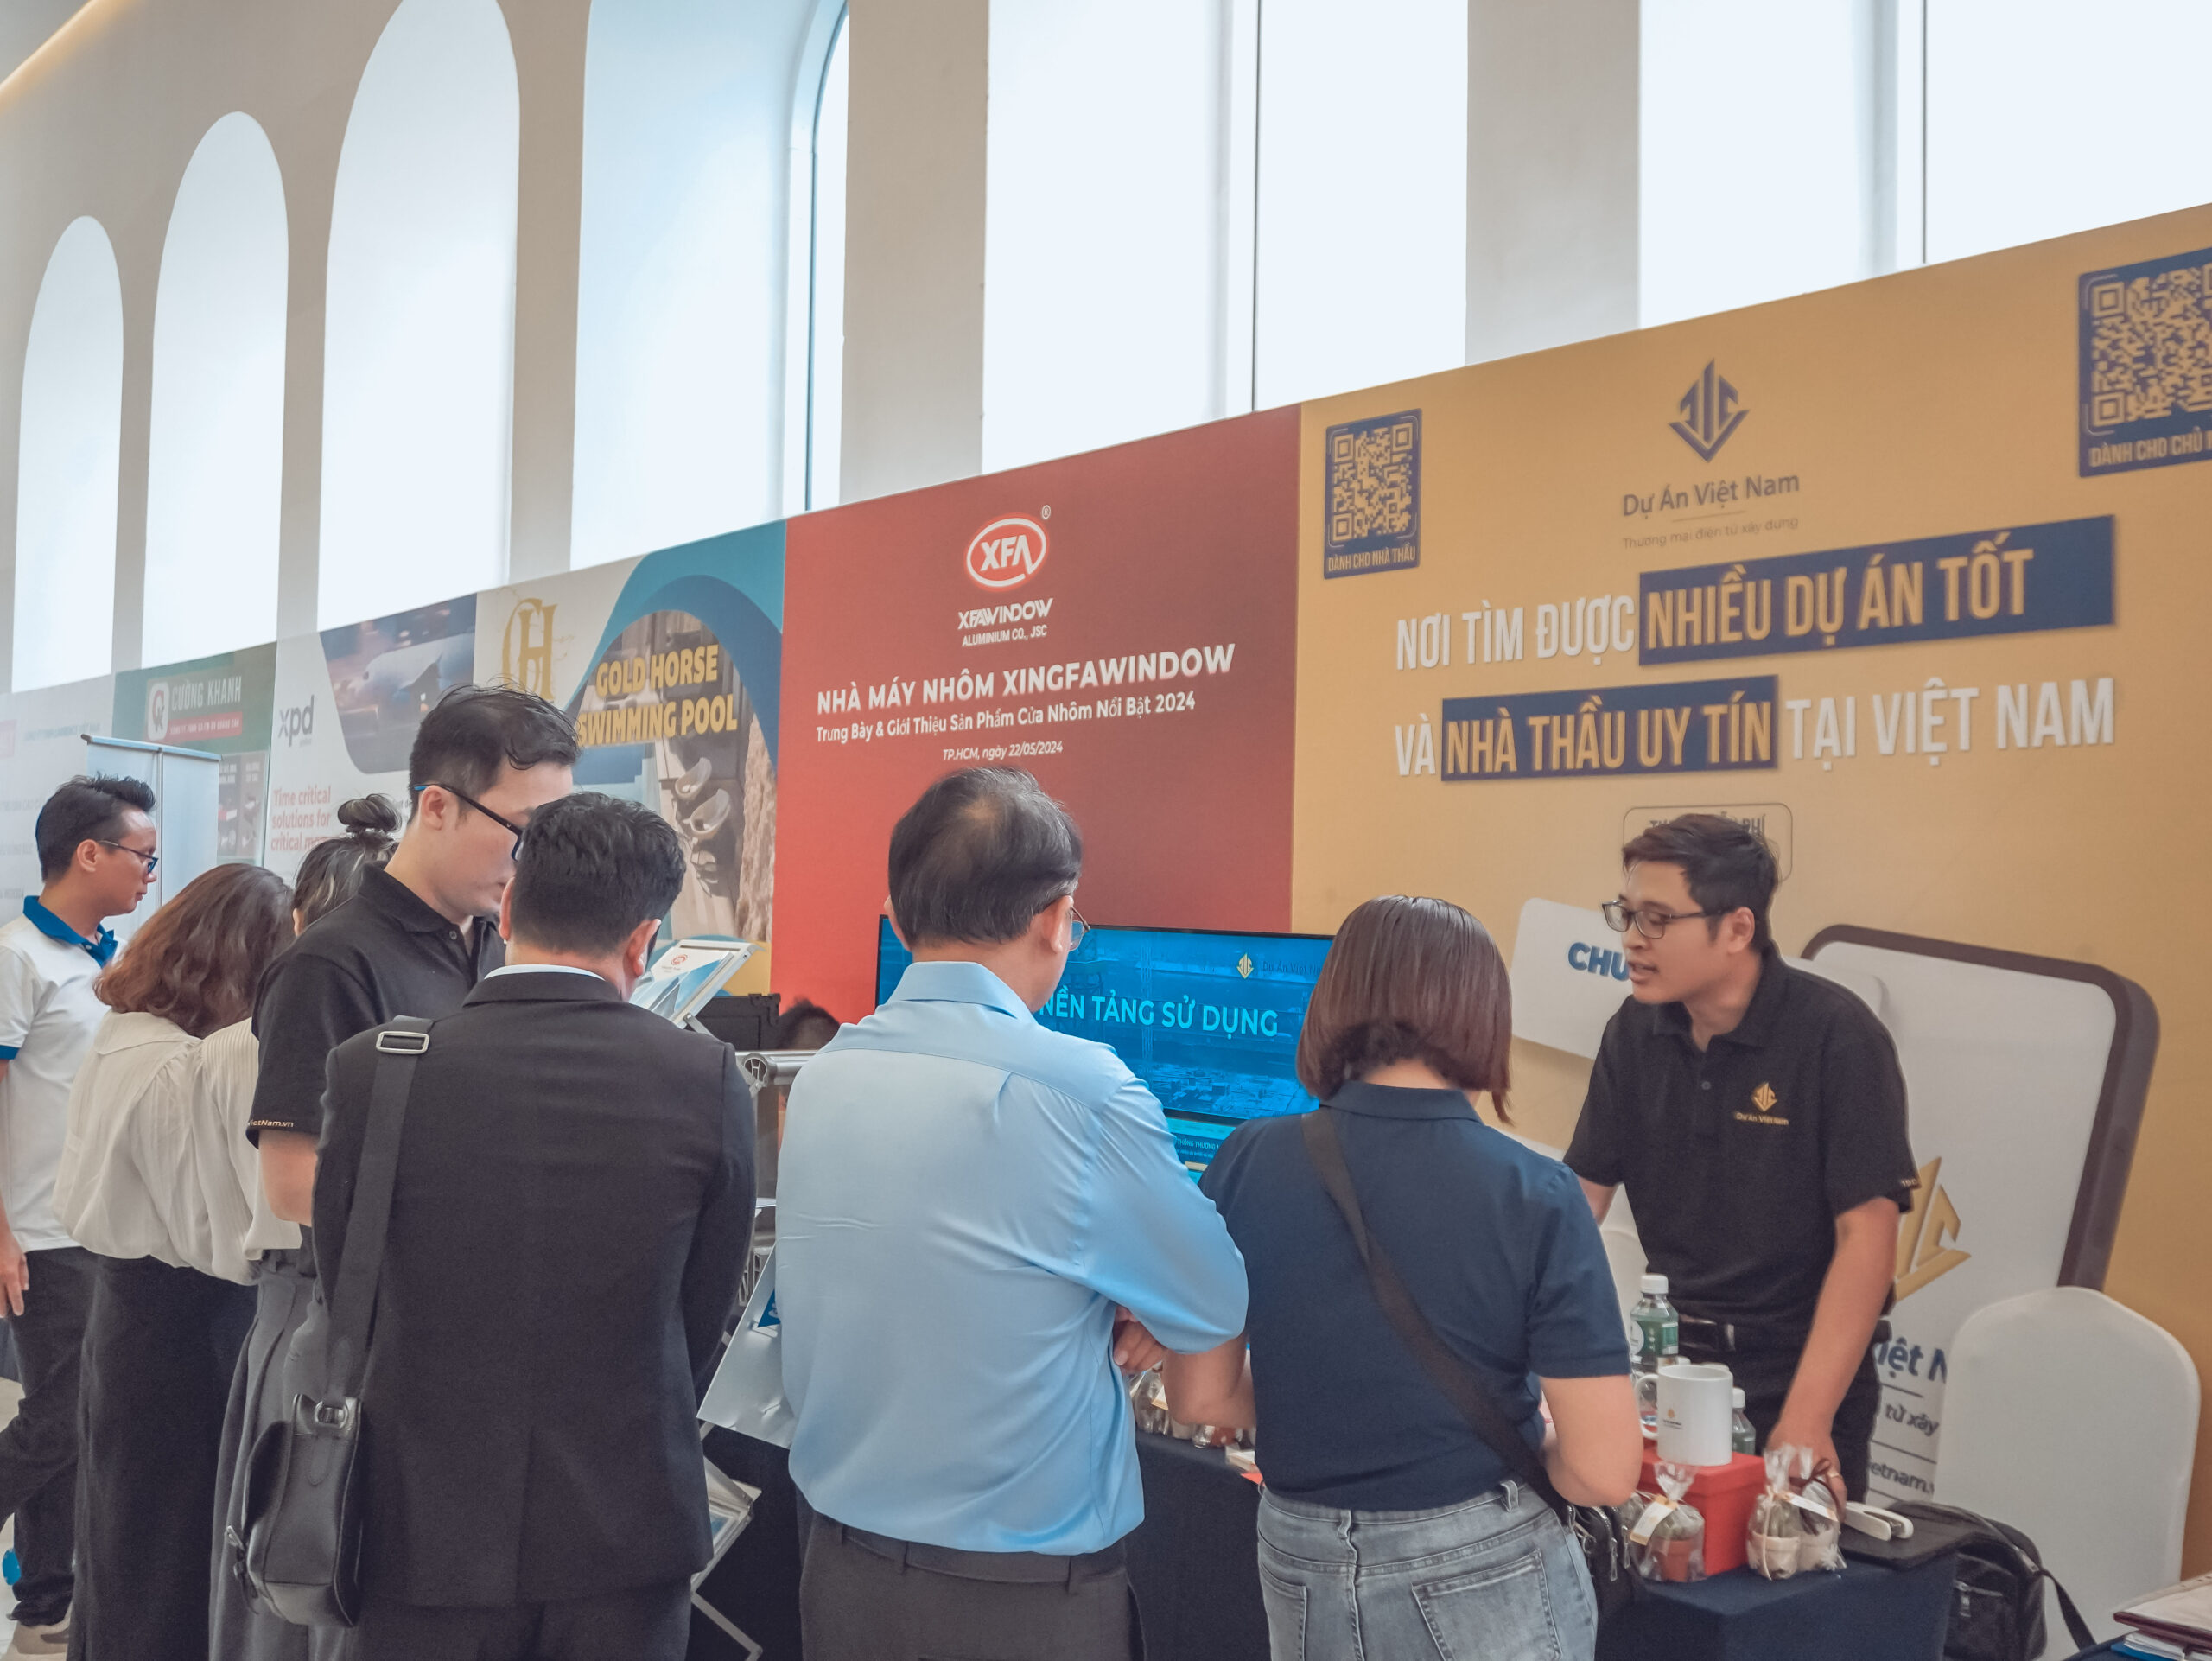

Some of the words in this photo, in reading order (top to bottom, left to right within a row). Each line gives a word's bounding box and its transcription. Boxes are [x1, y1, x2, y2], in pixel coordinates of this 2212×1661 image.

[2136, 436, 2168, 461] CHO
[1624, 493, 1655, 519] Dự
[1660, 484, 1688, 512] Án
[1694, 480, 1738, 509] Việt
[1745, 474, 1800, 499] Nam
[980, 534, 1034, 574] XFA
[1328, 554, 1351, 571] DÀNH
[1353, 552, 1370, 568] CHO
[1372, 546, 1390, 566] NHÀ
[957, 598, 1054, 630] XFAWINDOW
[1396, 613, 1451, 671] NƠI
[1461, 600, 1524, 665] TÌM
[1536, 594, 1635, 665] ĐƯỢC
[1648, 564, 1772, 649] NHIỀU
[1785, 566, 1847, 646] DỰ
[1857, 553, 1923, 631] ÁN
[1936, 531, 2034, 622] TỐT
[962, 629, 1010, 647] ALUMINIUM
[1030, 624, 1048, 638] JSC
[207, 676, 242, 705] KHANH
[595, 657, 646, 698] GOLD
[650, 644, 719, 689] HORSE
[817, 680, 861, 715] NHÀ
[868, 675, 916, 710] MÁY
[923, 668, 995, 705] NHÔM
[1002, 643, 1236, 697] XINGFAWINDOW
[277, 694, 315, 748] xpd
[576, 701, 677, 747] SWIMMING
[680, 693, 738, 735] POOL
[817, 726, 848, 745] Trưng
[851, 721, 874, 743] Bày
[875, 721, 884, 737] &
[887, 717, 911, 736] Giới
[913, 716, 947, 736] Thiệu
[950, 713, 973, 731] Sản
[976, 708, 1014, 729] Phẩm
[1018, 705, 1044, 725] Cửa
[1047, 701, 1093, 722] Nhôm
[1096, 696, 1122, 718] Nổi
[1126, 695, 1152, 719] Bật
[1155, 690, 1196, 714] 2024
[1394, 713, 1436, 776] VÀ
[1446, 707, 1518, 775] NHÀ
[1529, 695, 1626, 771] THẦU
[1641, 707, 1692, 767] UY
[1702, 691, 1772, 764] TÍN
[1786, 696, 1857, 771] TẠI
[1872, 677, 1980, 766] VIỆT
[1997, 678, 2114, 749] NAM
[982, 743, 1007, 761] ngày
[1008, 740, 1064, 757] 22/05/2024
[273, 787, 296, 806] Time
[298, 785, 332, 805] critical
[272, 811, 315, 830] solutions
[317, 807, 332, 827] for
[271, 831, 302, 851] critical
[1039, 984, 1084, 1019] NỀN
[1092, 989, 1154, 1026] TẢNG
[1162, 994, 1196, 1029] SỬ
[1202, 1004, 1278, 1040] DỤNG
